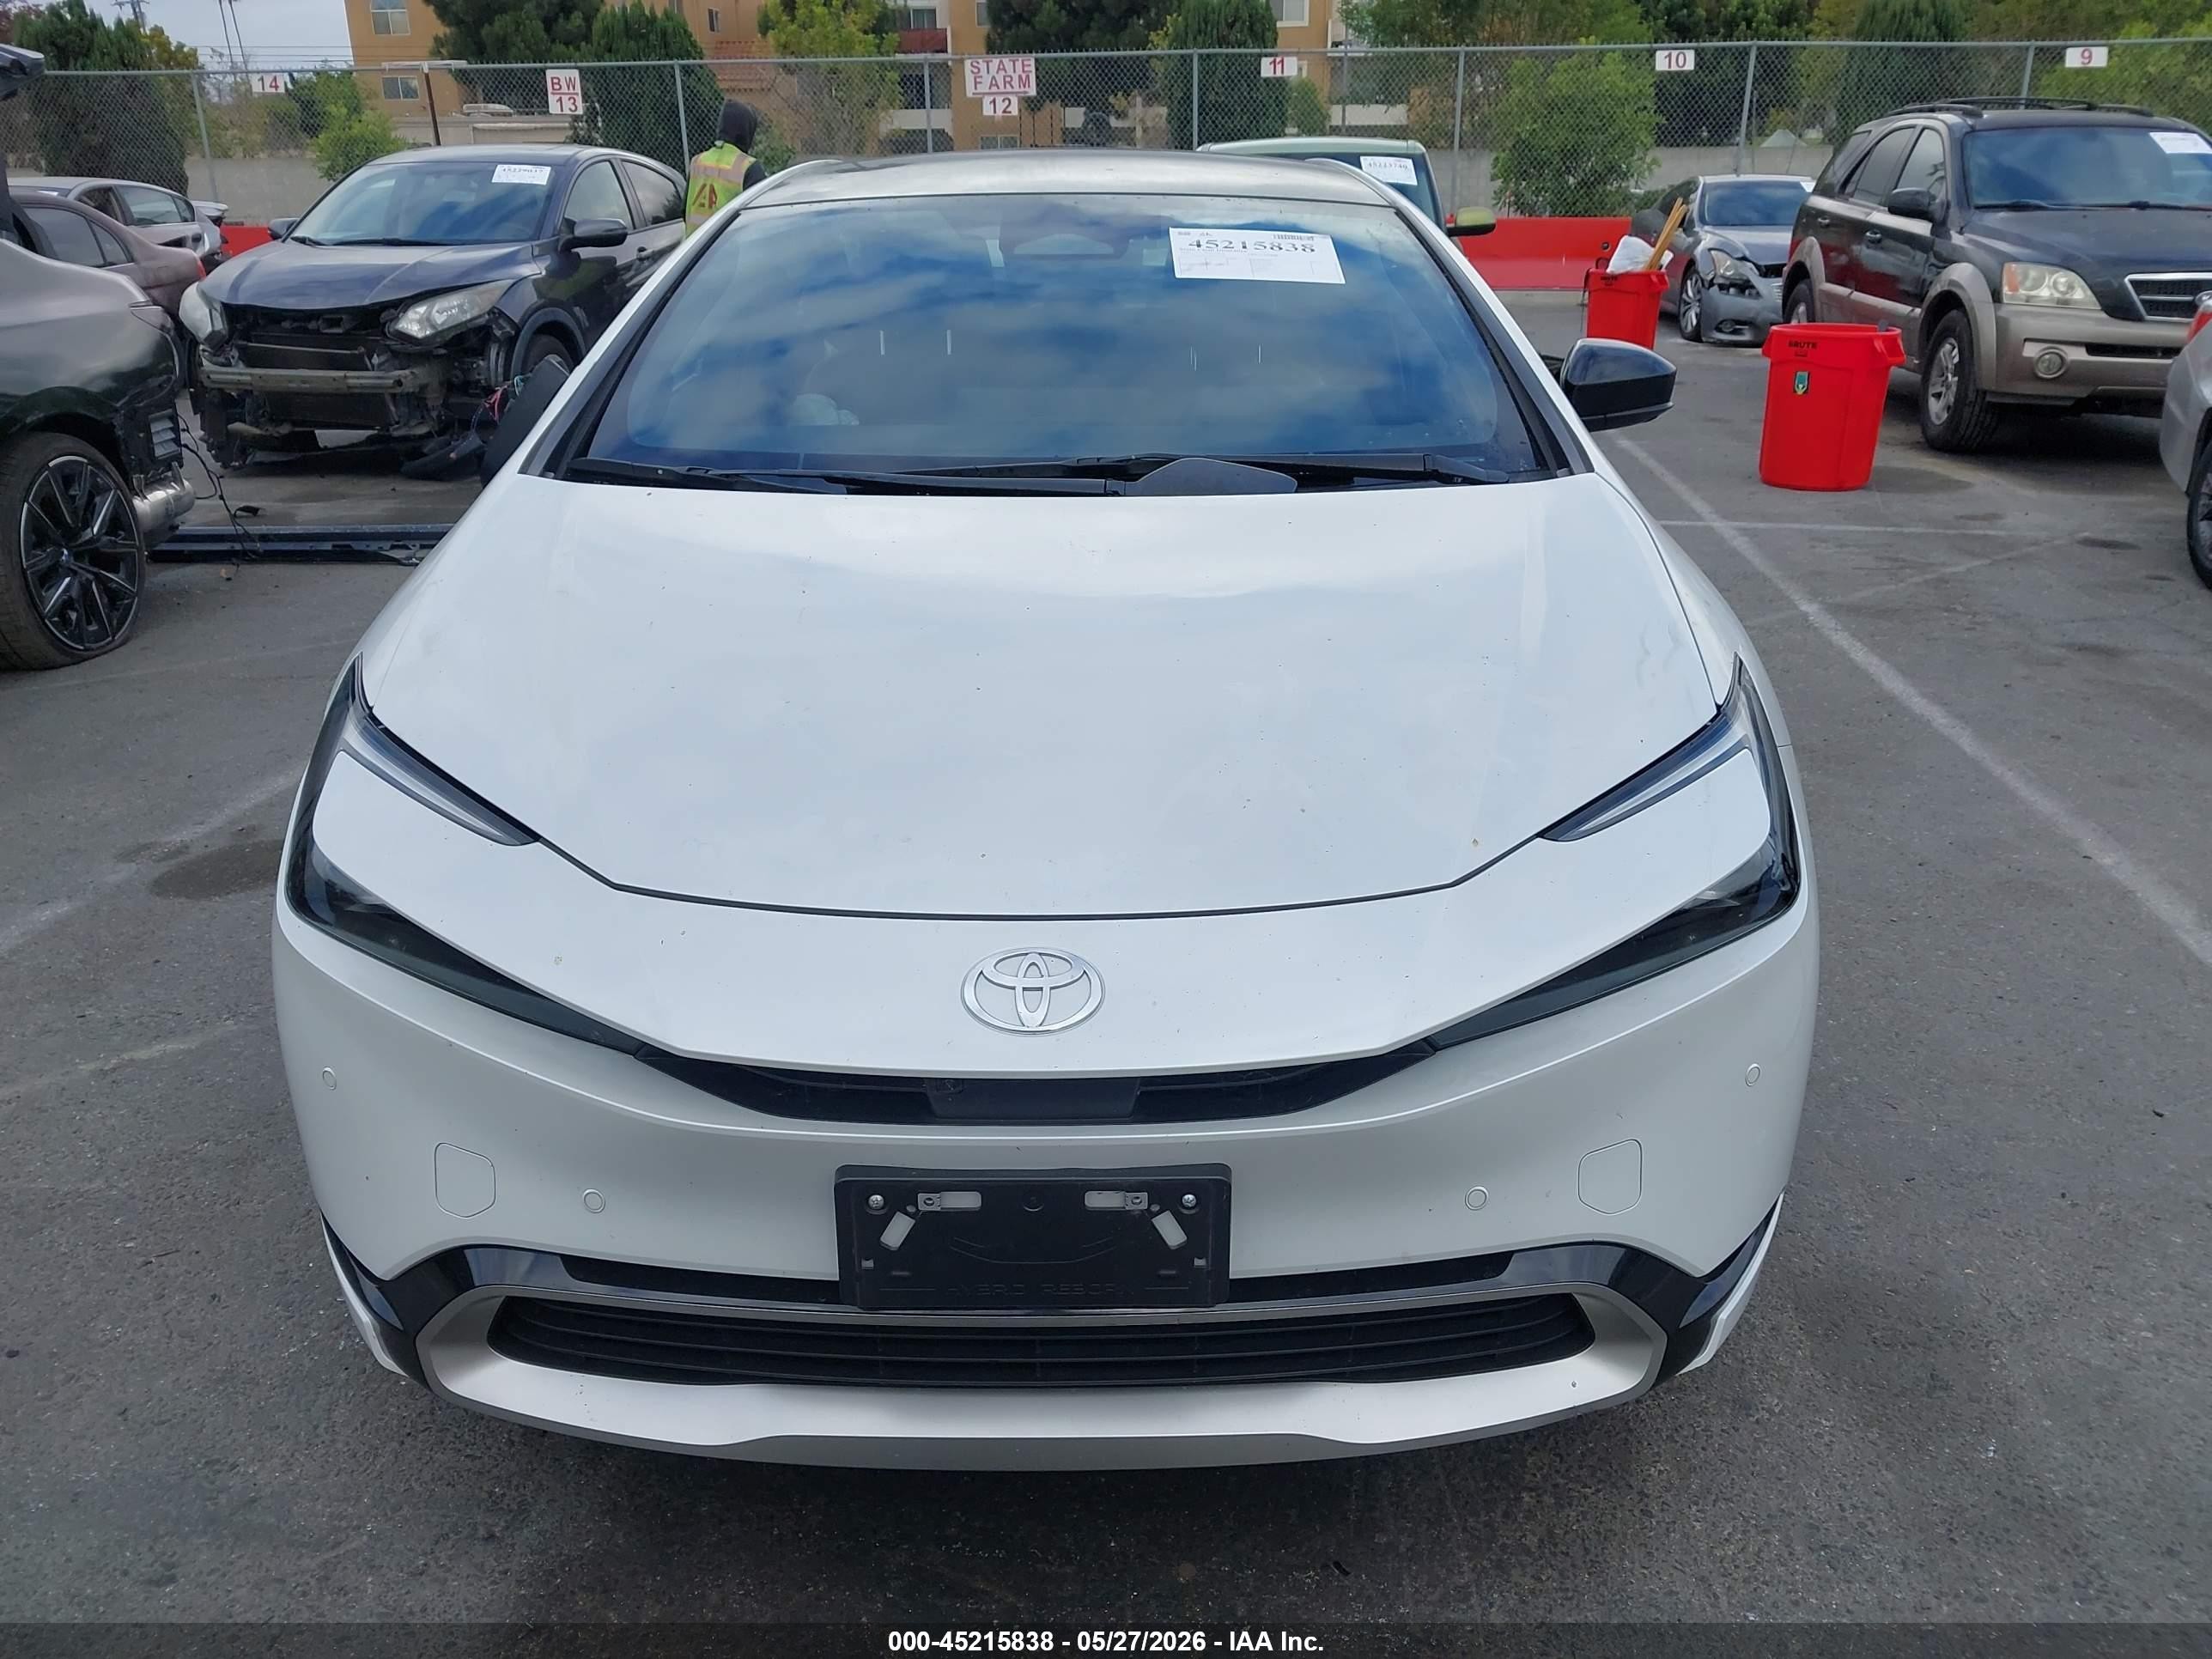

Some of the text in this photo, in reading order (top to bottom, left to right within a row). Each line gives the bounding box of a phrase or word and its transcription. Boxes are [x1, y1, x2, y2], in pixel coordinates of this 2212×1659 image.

[1664, 51, 1687, 70] 10
[2081, 47, 2093, 65] 9
[969, 58, 1033, 76] STATE
[1269, 57, 1285, 75] 11
[258, 75, 280, 92] 14
[550, 76, 576, 91] BW
[973, 74, 1031, 91] FARM
[556, 96, 578, 112] 13
[988, 96, 1012, 115] 12
[1188, 239, 1316, 253] 45215838
